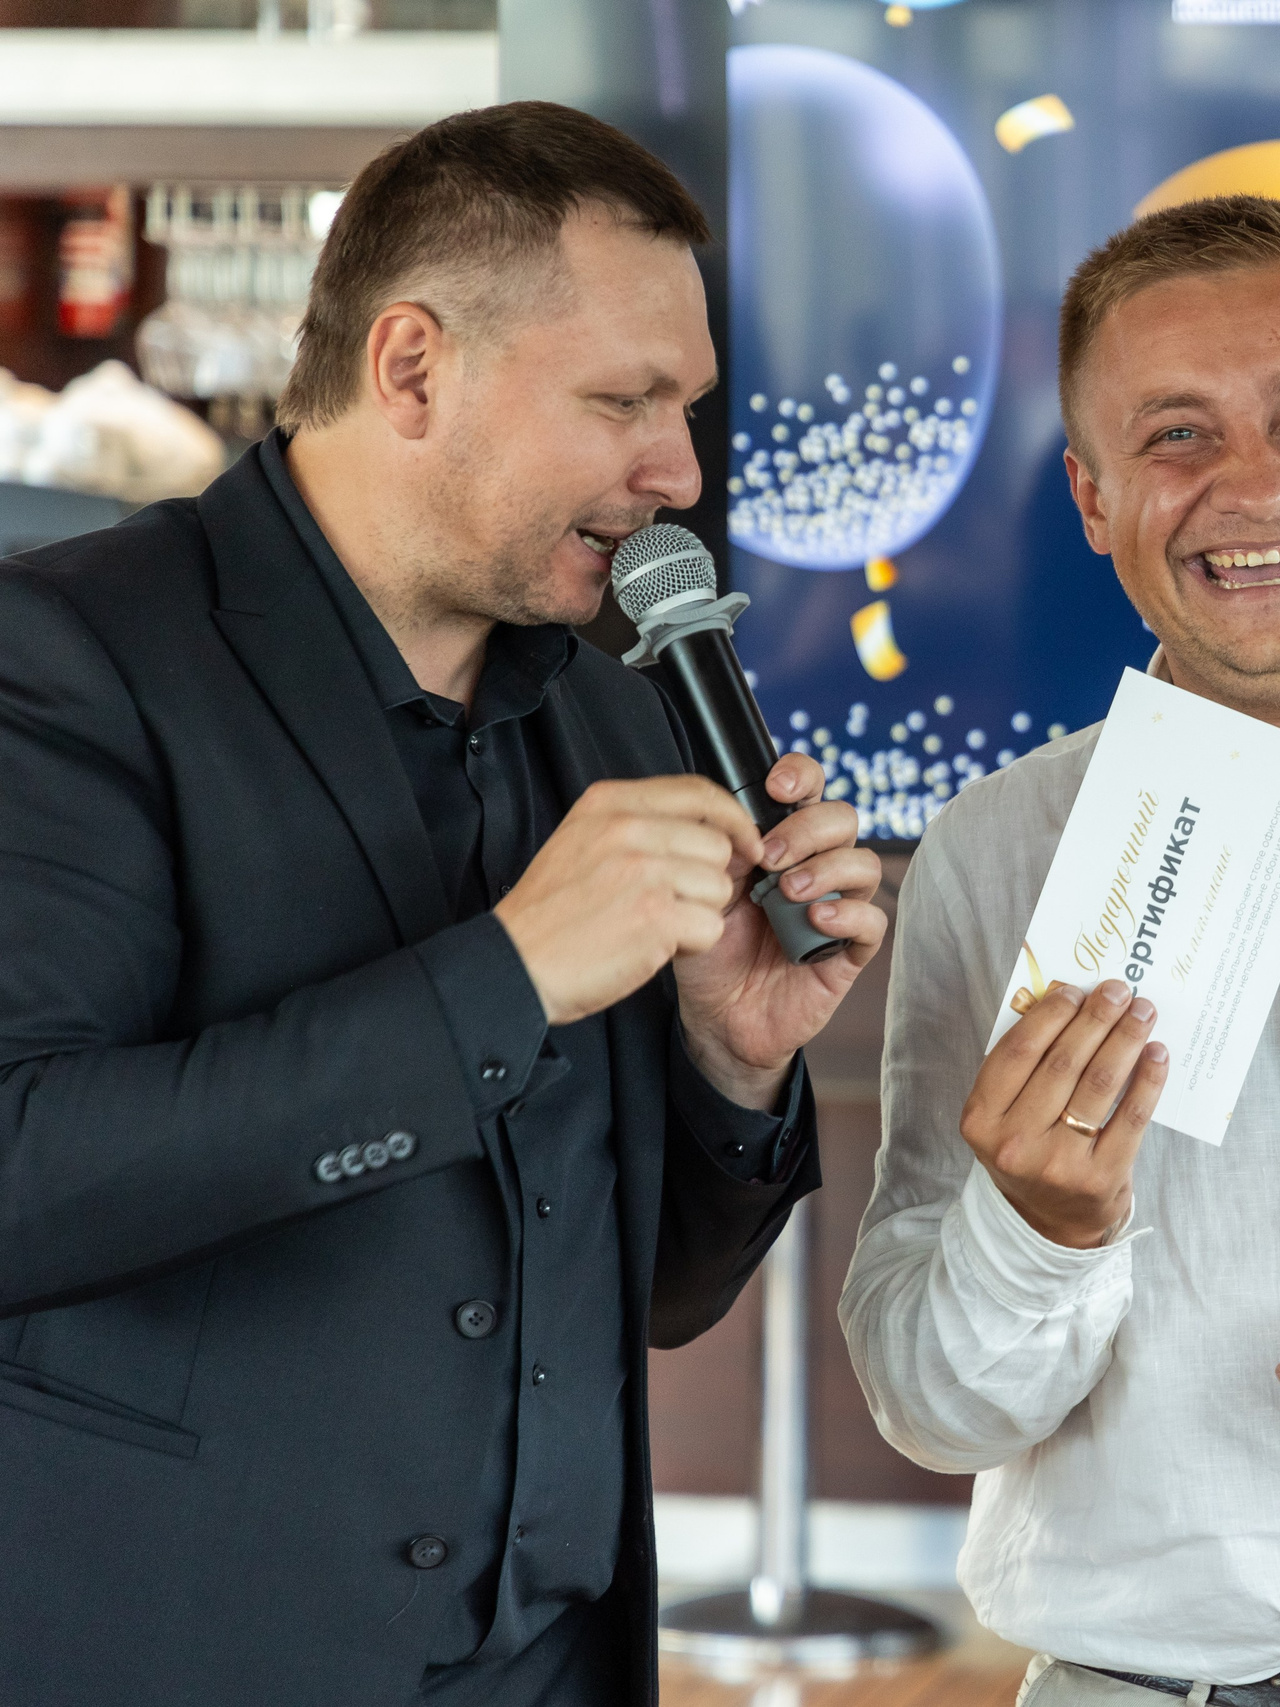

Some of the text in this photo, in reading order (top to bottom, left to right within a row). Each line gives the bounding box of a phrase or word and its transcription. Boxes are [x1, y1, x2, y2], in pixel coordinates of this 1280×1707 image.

[1073, 789, 1159, 982] Подарочный
[1123, 796, 1201, 997] ертификат
[1179, 1052, 1192, 1068] На
[1188, 1009, 1207, 1051] неделю
[1203, 947, 1230, 1008] установить
[1226, 931, 1236, 945] на
[1231, 882, 1253, 930] рабочем
[1249, 849, 1266, 881] столе
[1187, 1025, 1216, 1091] компьютера
[1211, 1015, 1219, 1023] и
[1215, 1000, 1225, 1014] на
[1220, 937, 1247, 998] мобильном
[1242, 882, 1267, 934] телефоне
[1263, 853, 1279, 881] обои
[1205, 1071, 1213, 1079] с
[1209, 989, 1242, 1070] изображением
